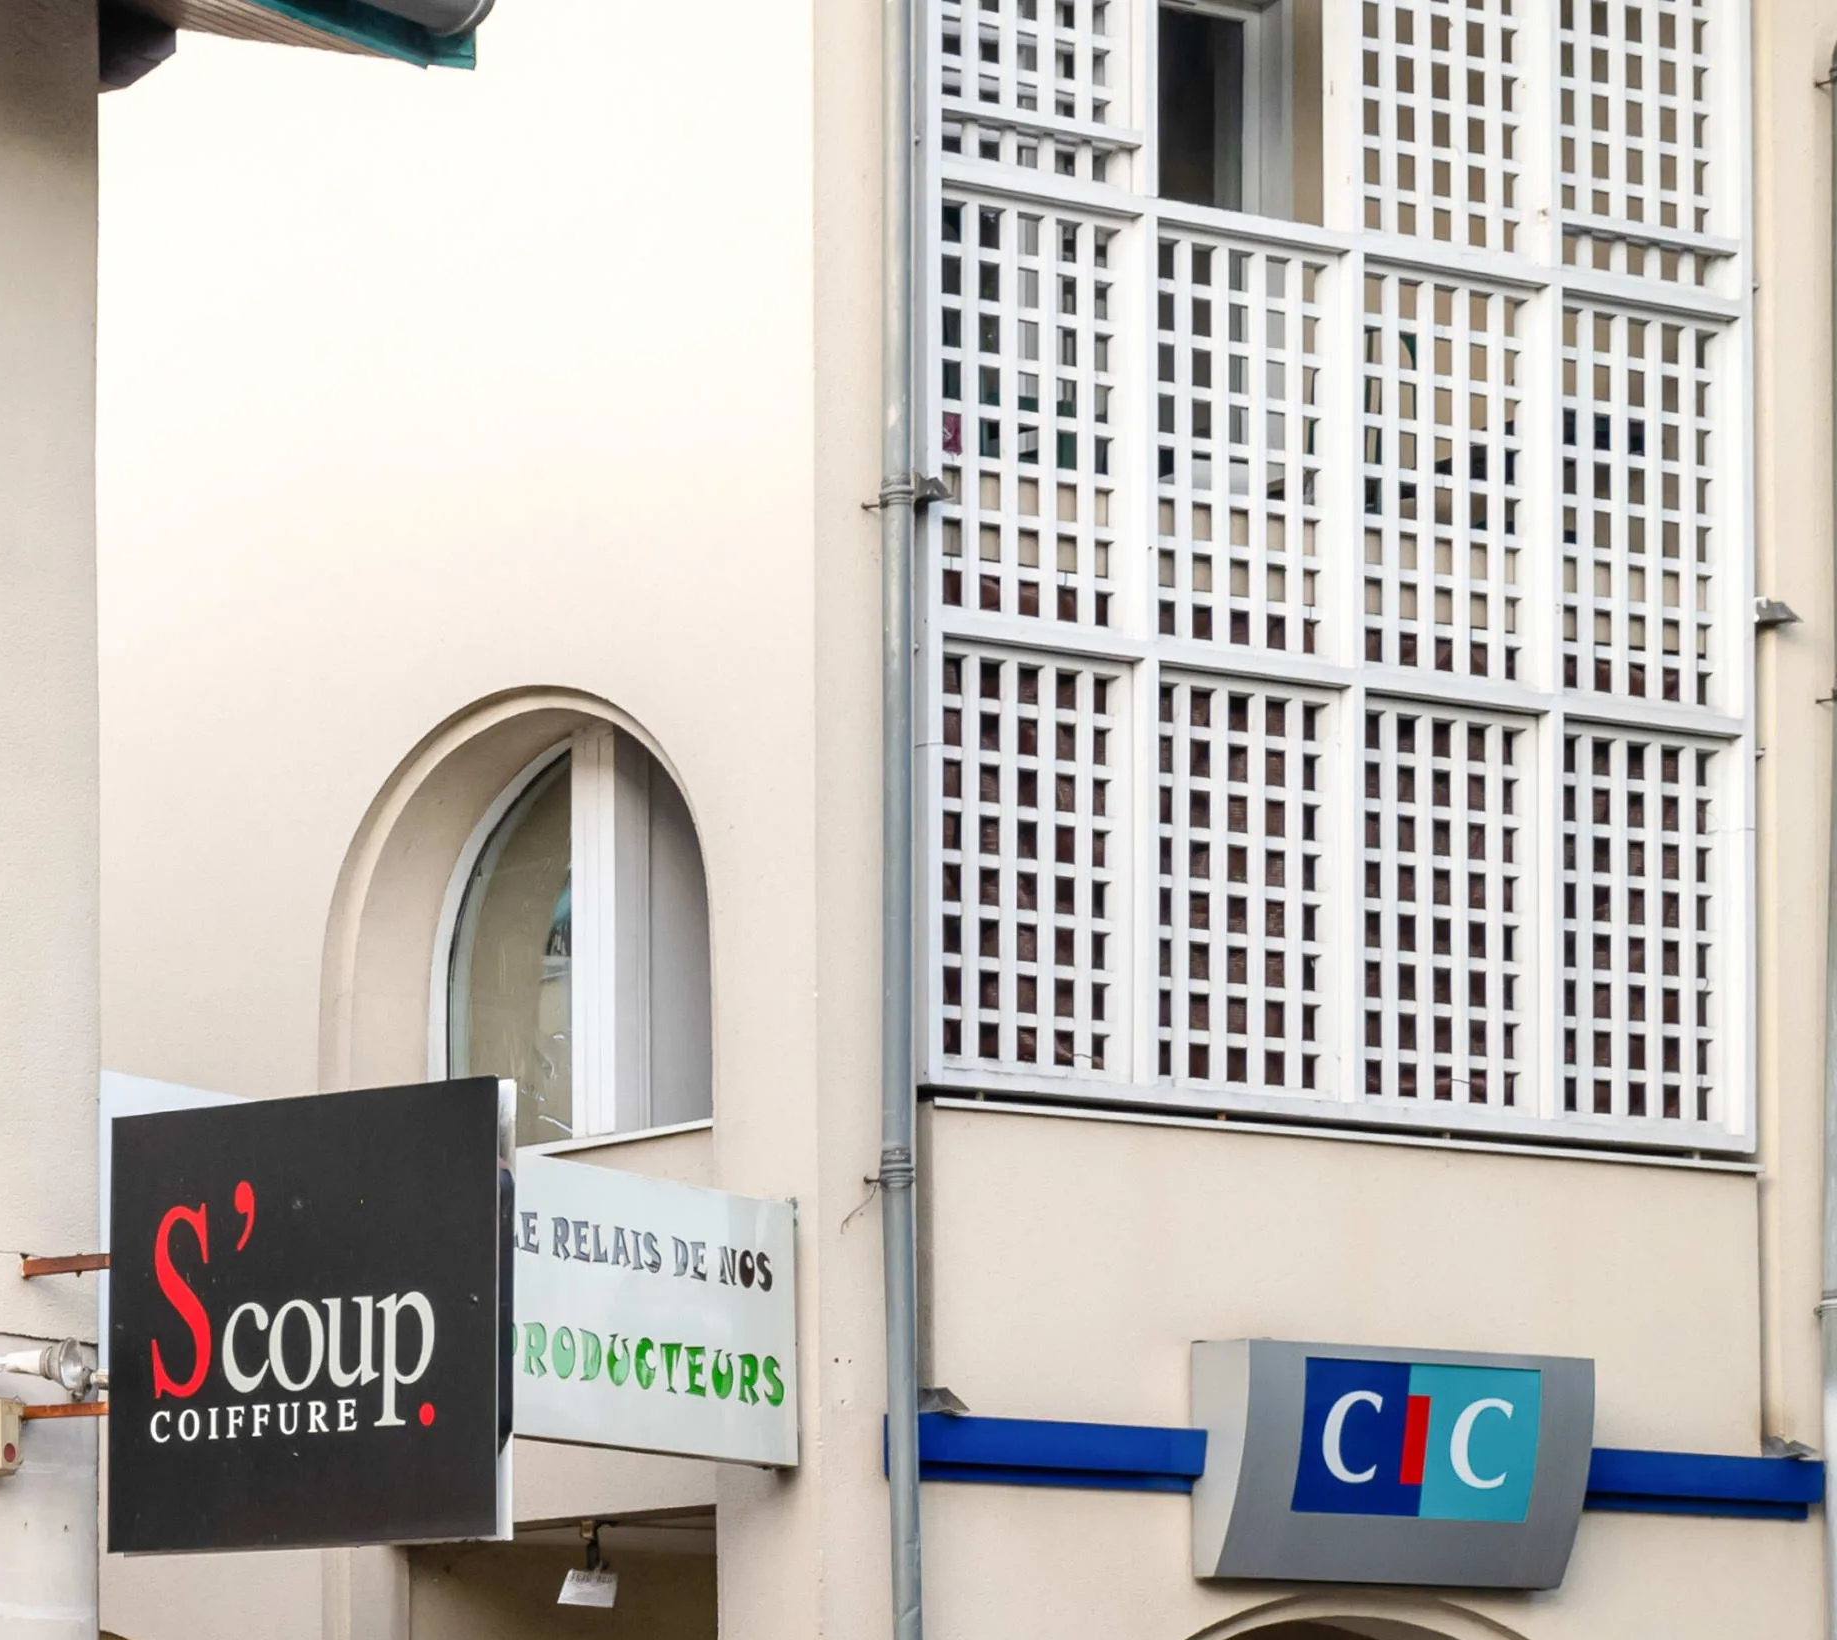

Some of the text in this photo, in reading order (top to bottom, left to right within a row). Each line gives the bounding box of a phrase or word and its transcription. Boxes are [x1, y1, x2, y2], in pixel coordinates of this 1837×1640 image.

[551, 1216, 662, 1274] RELAIS
[671, 1235, 708, 1282] DE
[718, 1245, 773, 1293] NOS
[513, 1321, 785, 1408] RODUCTEURS
[149, 1398, 358, 1444] COIFFURE
[1322, 1389, 1514, 1490] CIC
